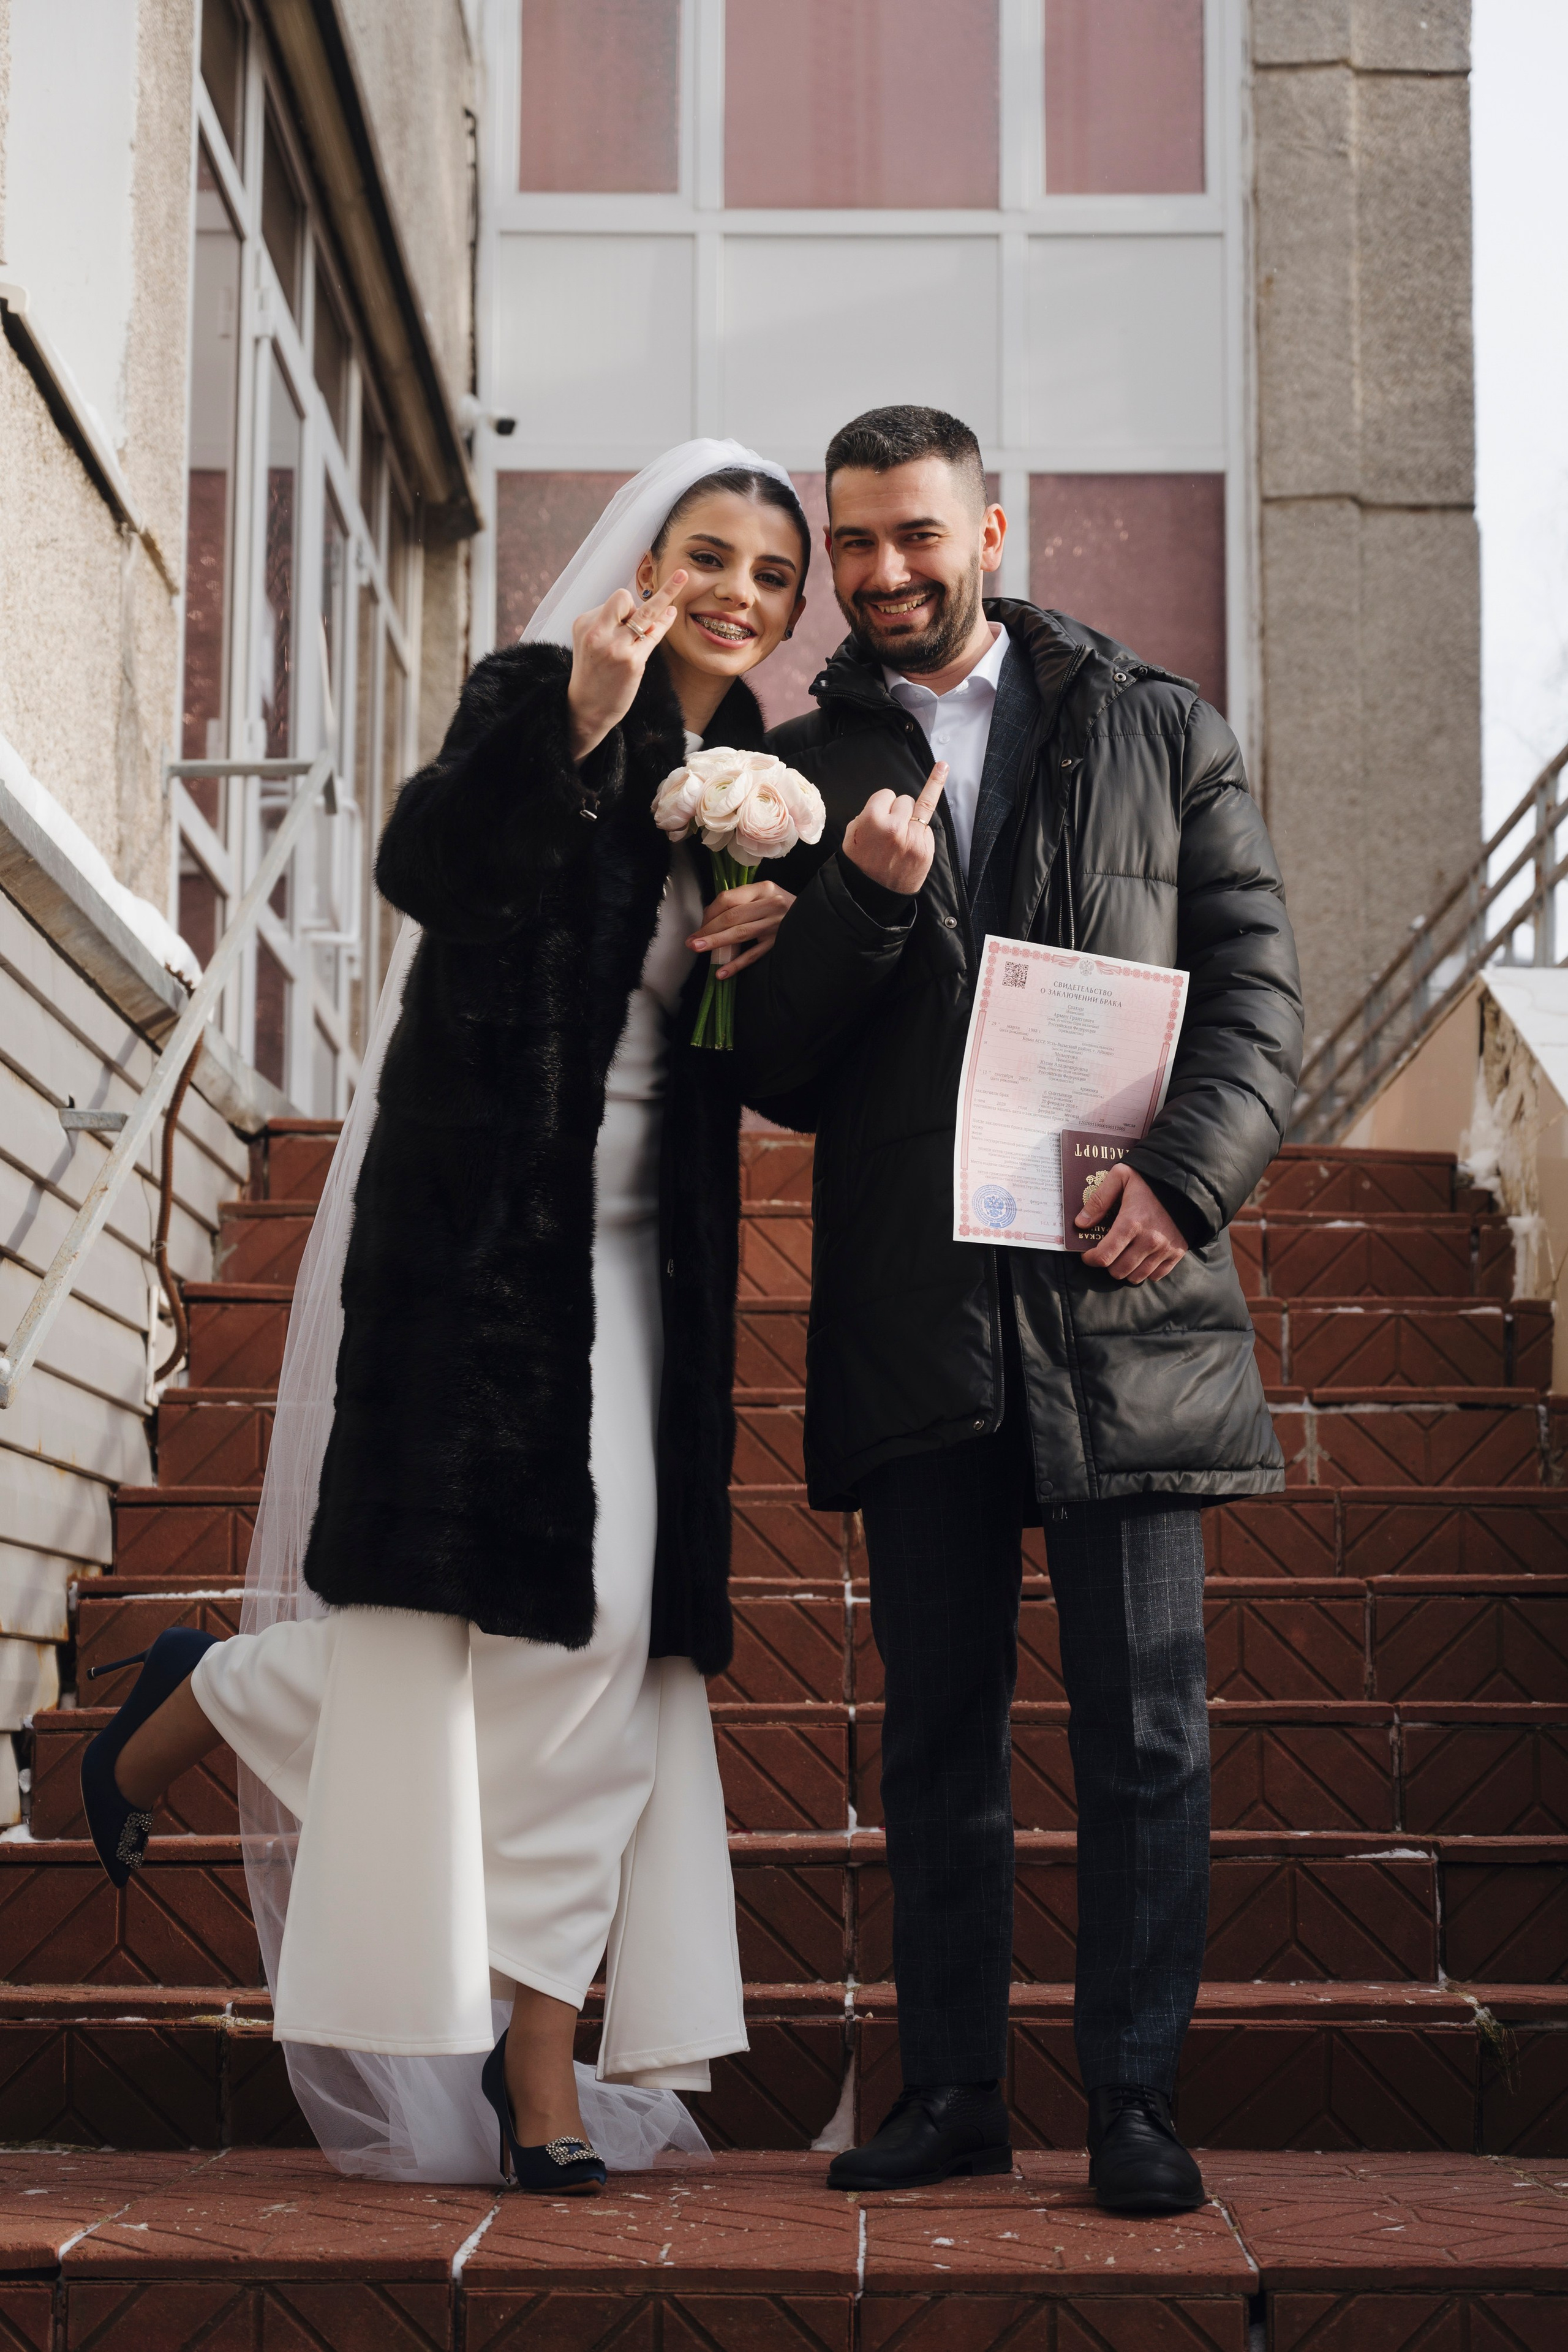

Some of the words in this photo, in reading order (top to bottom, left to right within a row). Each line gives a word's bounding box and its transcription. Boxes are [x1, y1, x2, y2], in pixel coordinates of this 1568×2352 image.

[1054, 981, 1112, 997] СВИДЕТЕЛЬСТВО
[1047, 989, 1098, 1003] ЗАКЛЮЧЕНИИ
[1099, 998, 1121, 1007] БРАКА
[1072, 1025, 1096, 1034] Федерация
[1054, 1062, 1088, 1072] Владимировна
[1063, 1074, 1086, 1082] Федерация
[1075, 1143, 1129, 1159] АСПОРТ
